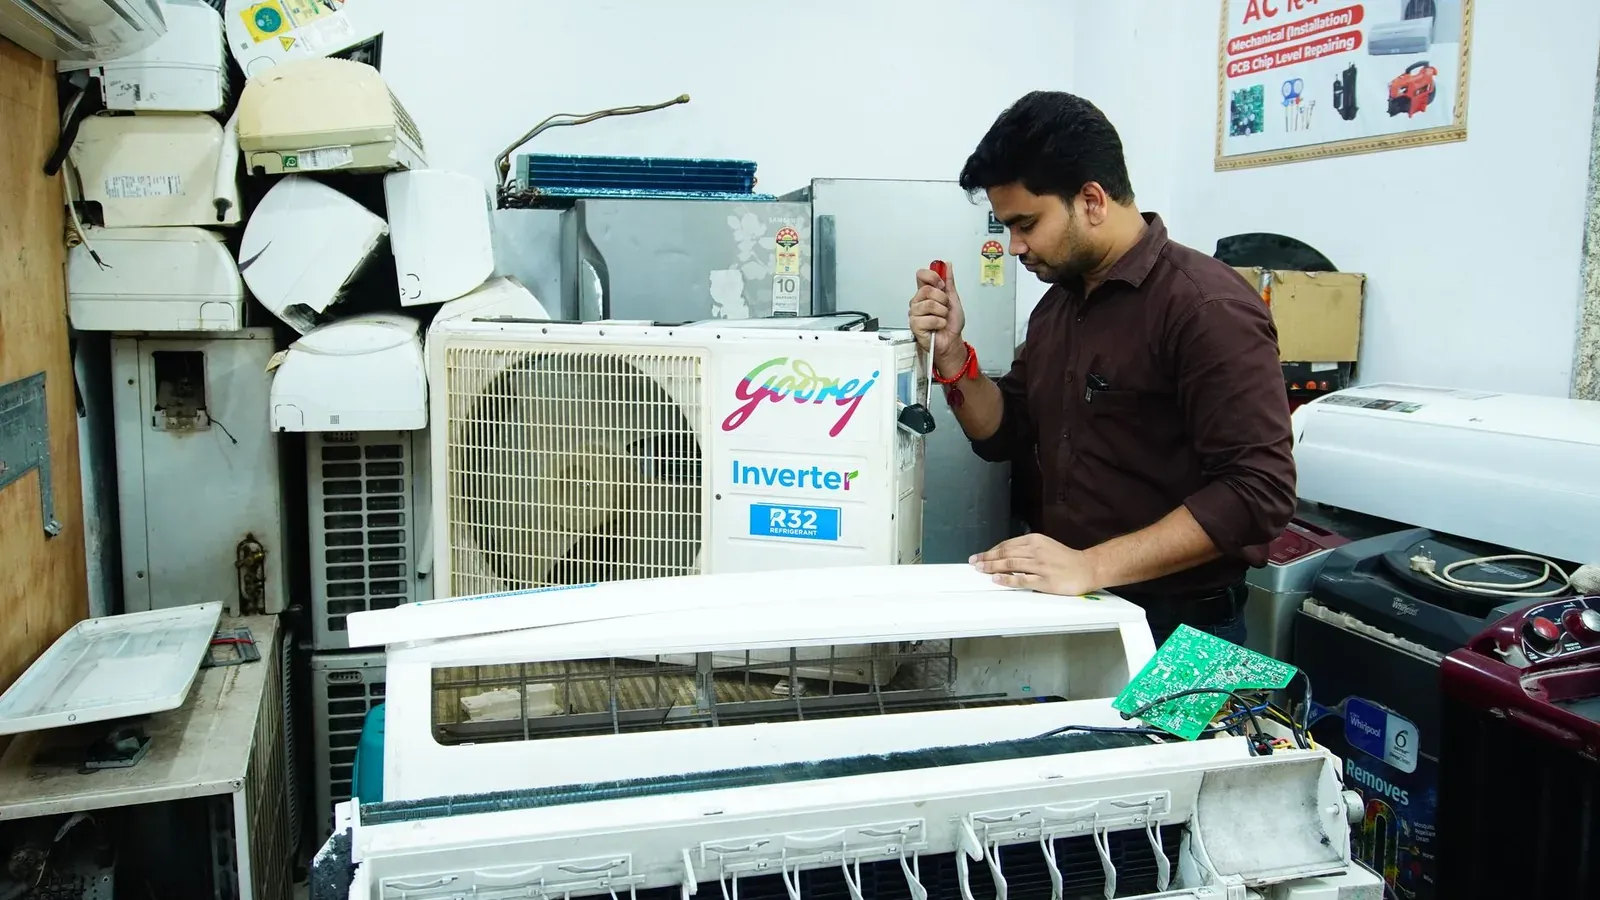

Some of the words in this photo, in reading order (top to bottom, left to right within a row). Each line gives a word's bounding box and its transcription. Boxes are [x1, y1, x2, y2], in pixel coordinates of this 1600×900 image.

[1231, 26, 1285, 52] Mechanical
[1286, 9, 1353, 40] (Installation)
[1231, 59, 1250, 75] PCB
[1252, 54, 1274, 69] Chip
[1275, 48, 1303, 64] Level
[1304, 36, 1355, 58] Repairing
[777, 278, 795, 293] 10
[721, 357, 880, 438] Godrej
[732, 460, 859, 491] Inverter
[769, 508, 818, 529] R32
[769, 528, 818, 536] REFRIGERANT
[1350, 716, 1381, 738] Whirlpool
[1346, 758, 1410, 806] Removes
